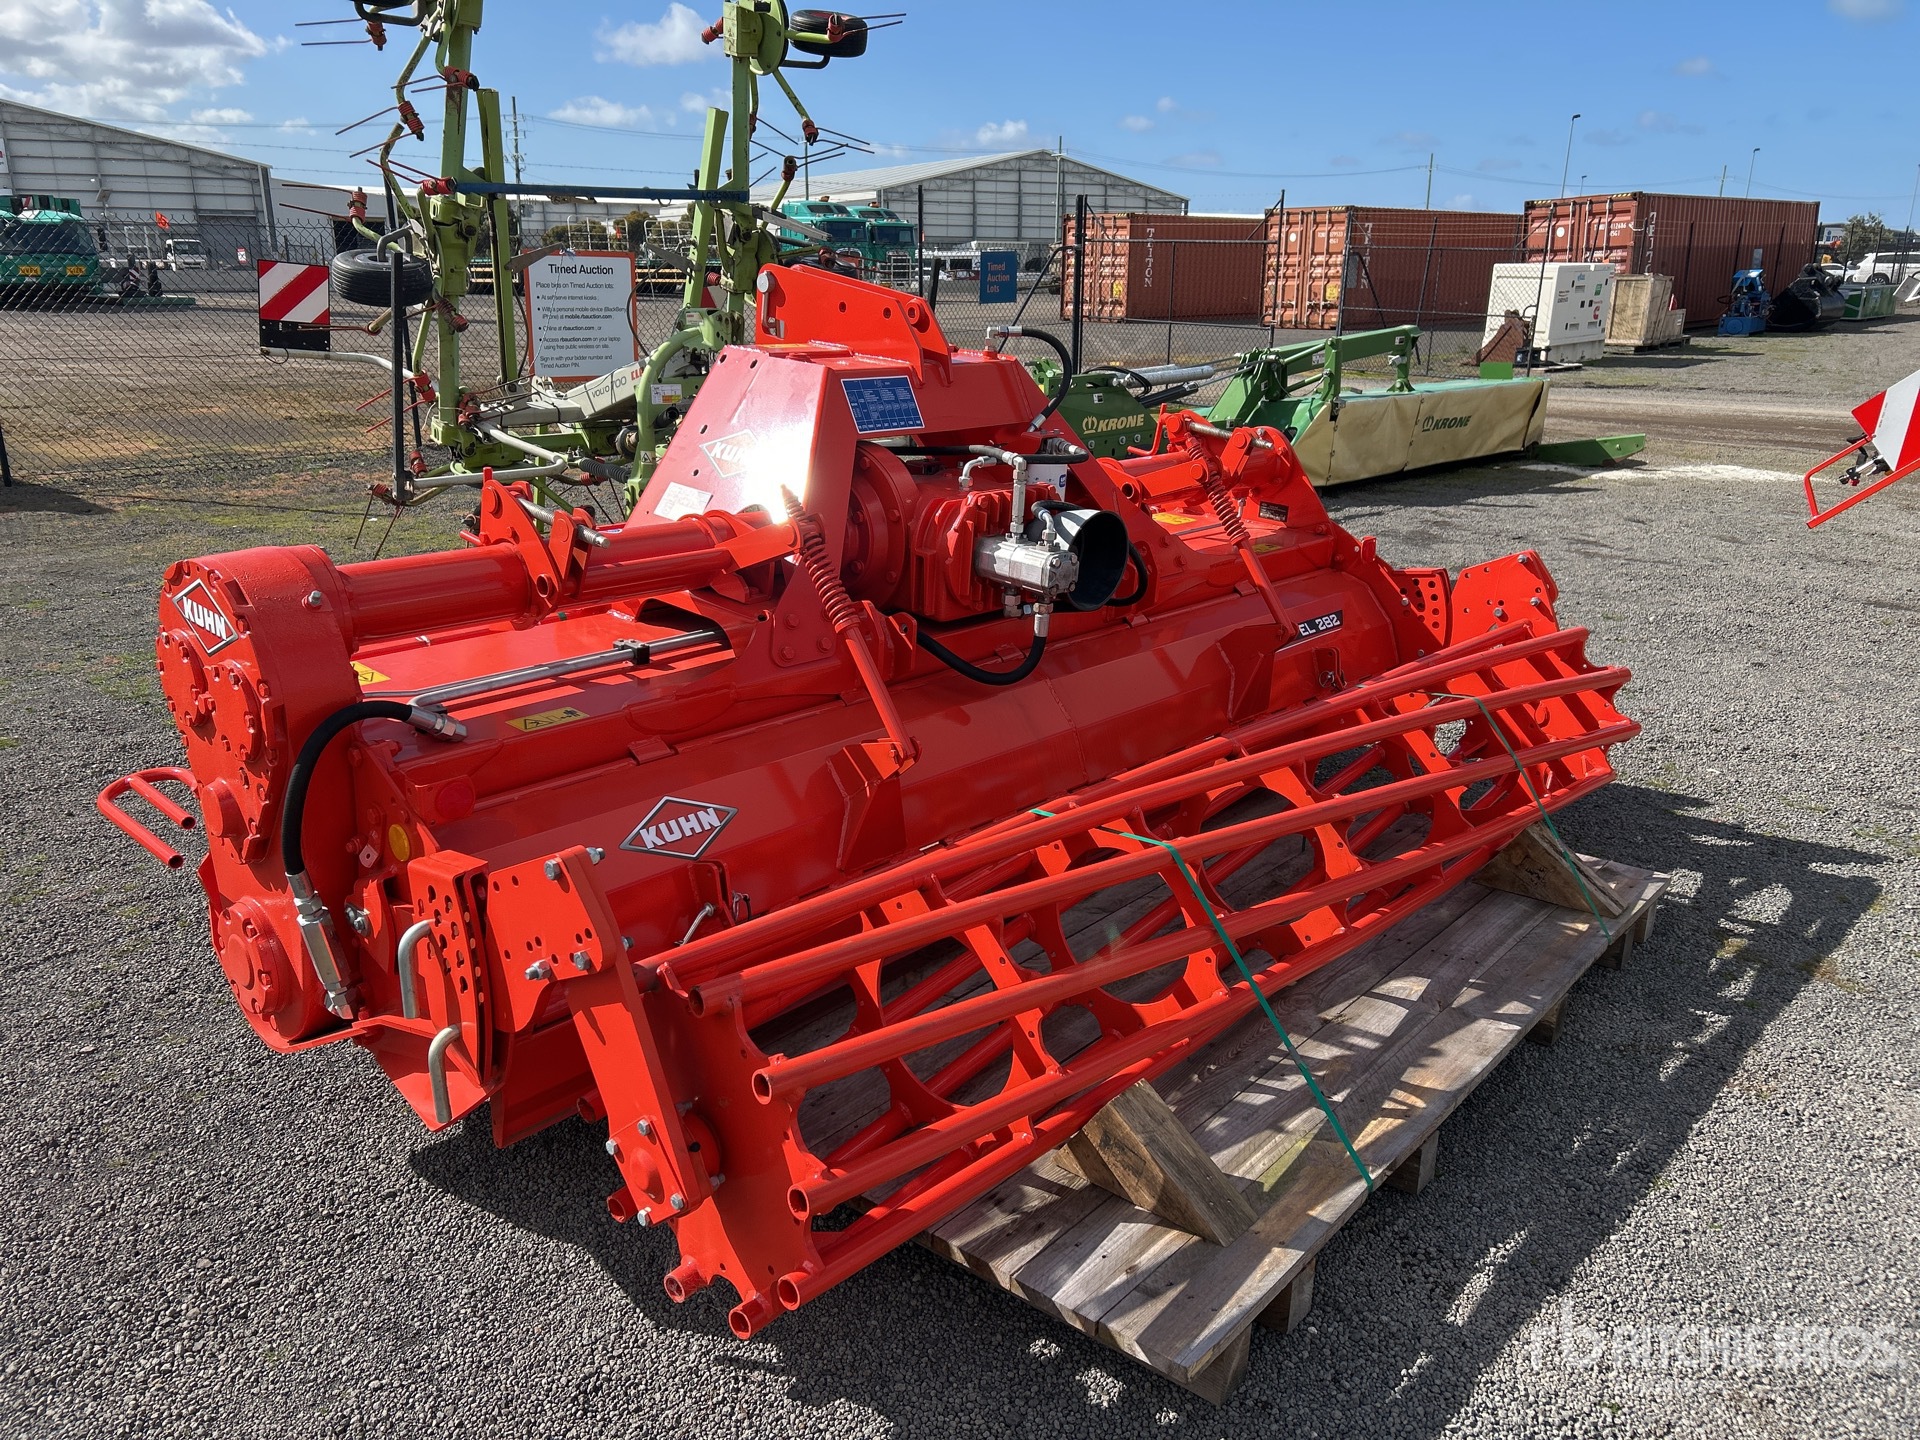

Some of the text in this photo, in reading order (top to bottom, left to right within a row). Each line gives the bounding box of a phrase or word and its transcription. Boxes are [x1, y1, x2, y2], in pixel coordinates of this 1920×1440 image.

[548, 264, 614, 274] Timed Auction
[987, 261, 1006, 270] Timed
[987, 273, 1010, 282] Auction
[986, 284, 1000, 292] Lots
[1097, 414, 1144, 432] KRONE
[1432, 415, 1472, 430] KRONE
[182, 596, 227, 640] KUHN
[1298, 614, 1340, 636] EL 282
[640, 807, 721, 850] KUHN
